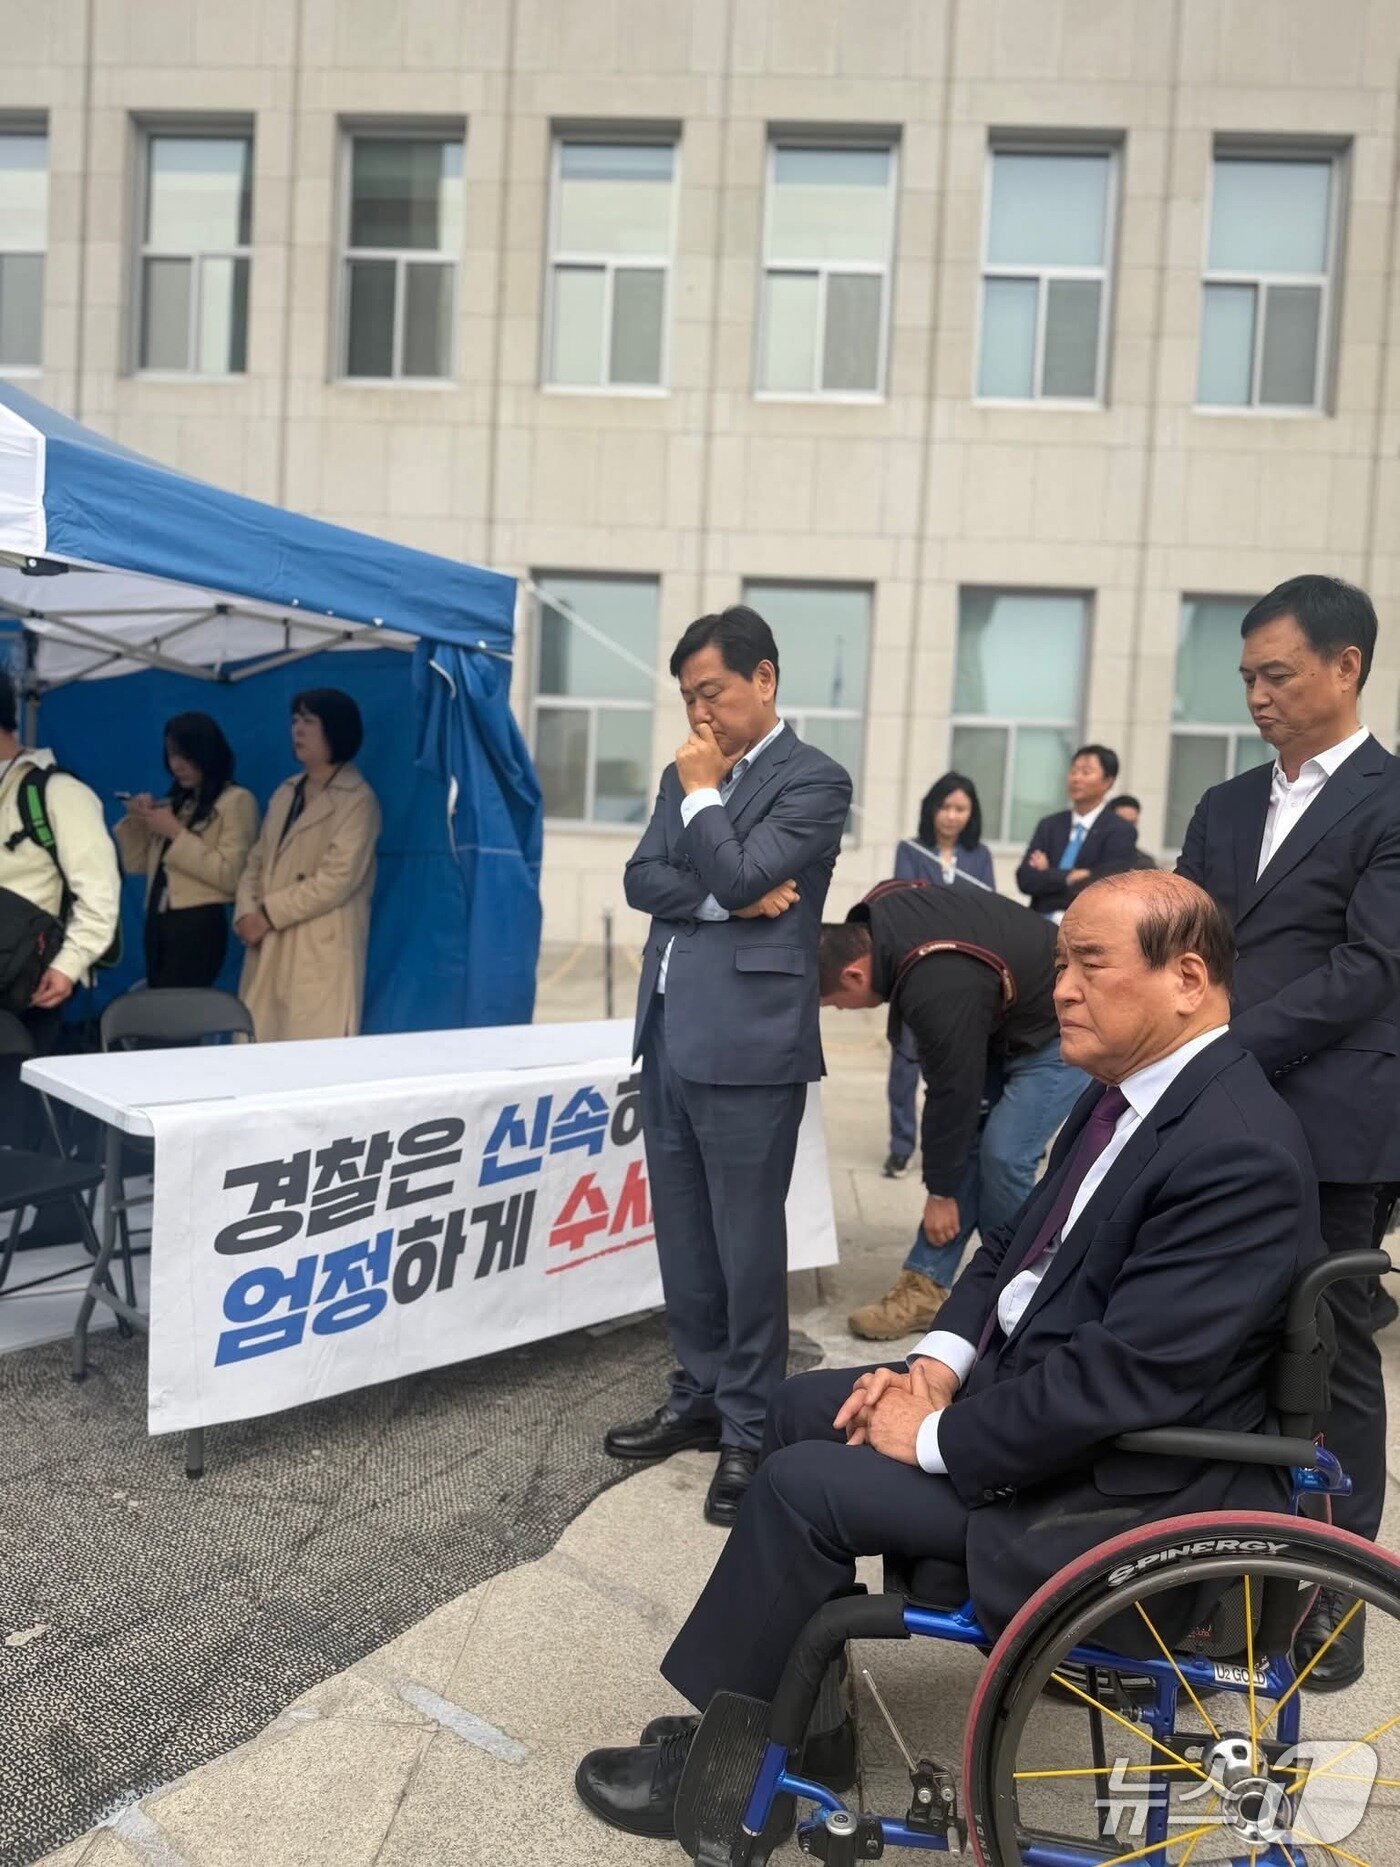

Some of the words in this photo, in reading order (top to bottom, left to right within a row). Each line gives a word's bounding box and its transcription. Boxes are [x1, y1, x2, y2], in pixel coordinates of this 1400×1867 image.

[214, 1117, 466, 1256] 경찰은
[214, 1190, 536, 1367] 엄정하게
[1107, 1539, 1290, 1587] SPINERGY
[1216, 1664, 1231, 1680] U2
[974, 1814, 994, 1867] ENDA
